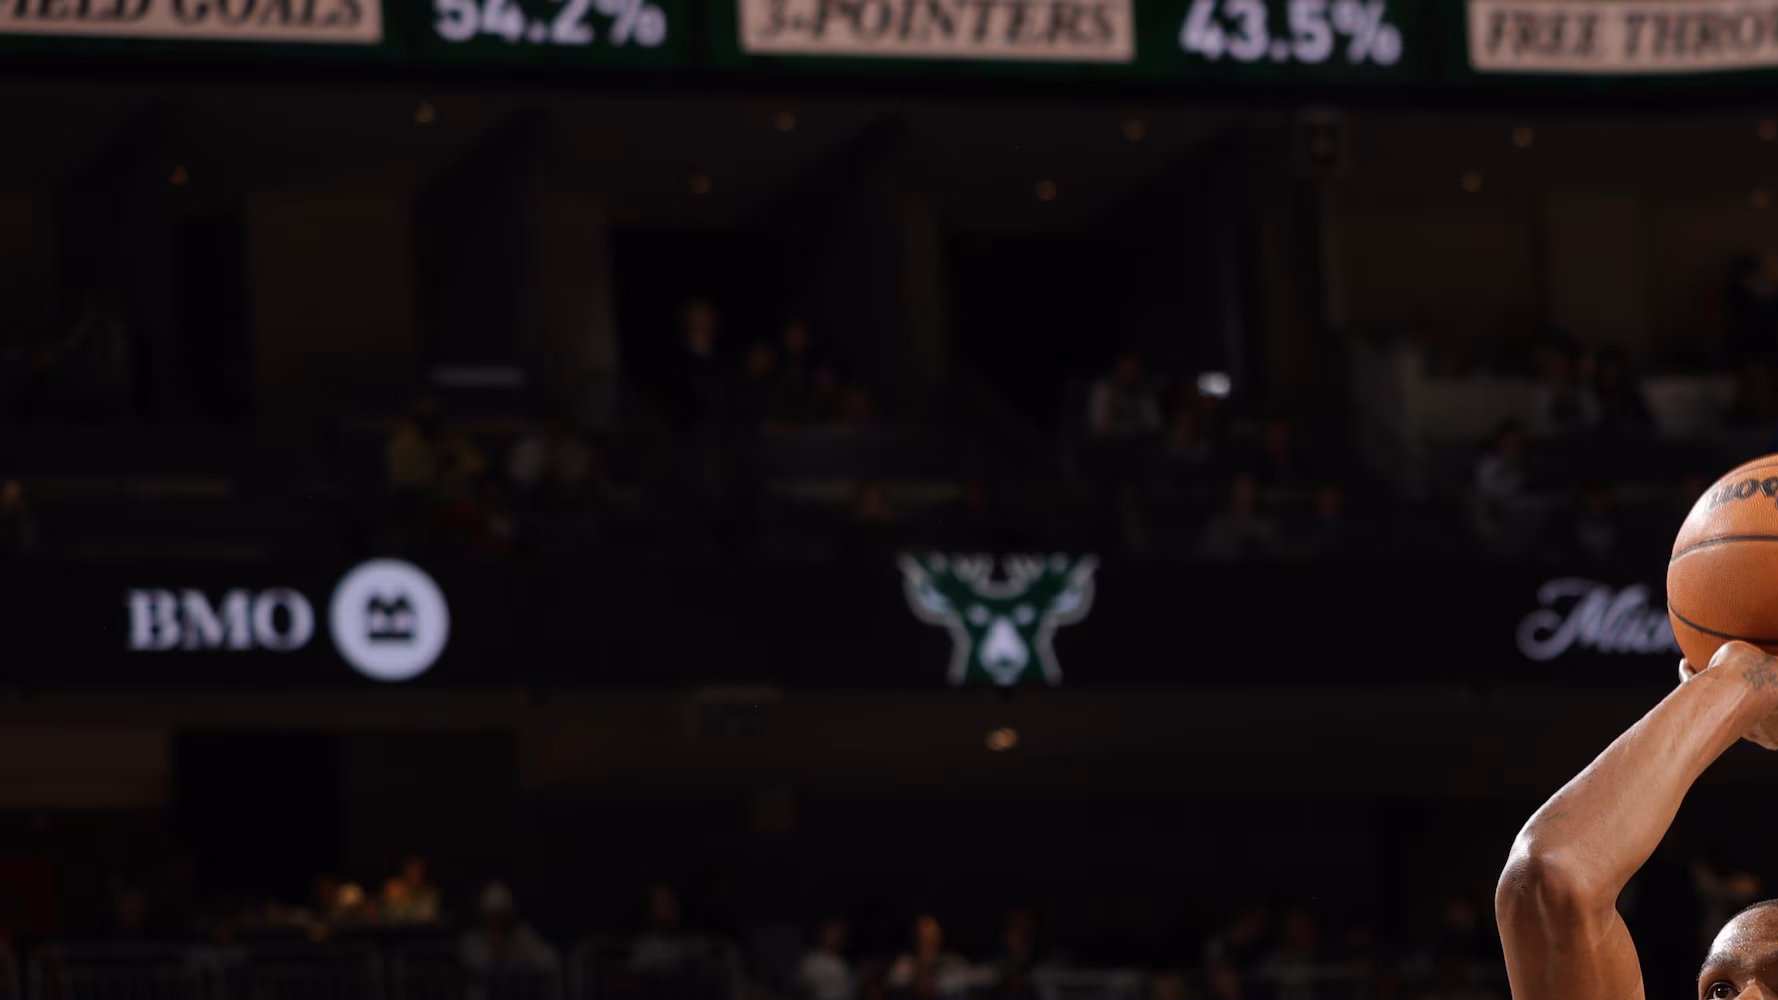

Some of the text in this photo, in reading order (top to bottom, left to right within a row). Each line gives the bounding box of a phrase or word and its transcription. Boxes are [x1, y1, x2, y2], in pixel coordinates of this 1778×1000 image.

[434, 0, 668, 47] 54.2%
[1180, 0, 1402, 65] 43.5%
[1486, 11, 1600, 57] FREE
[127, 586, 316, 652] BMO
